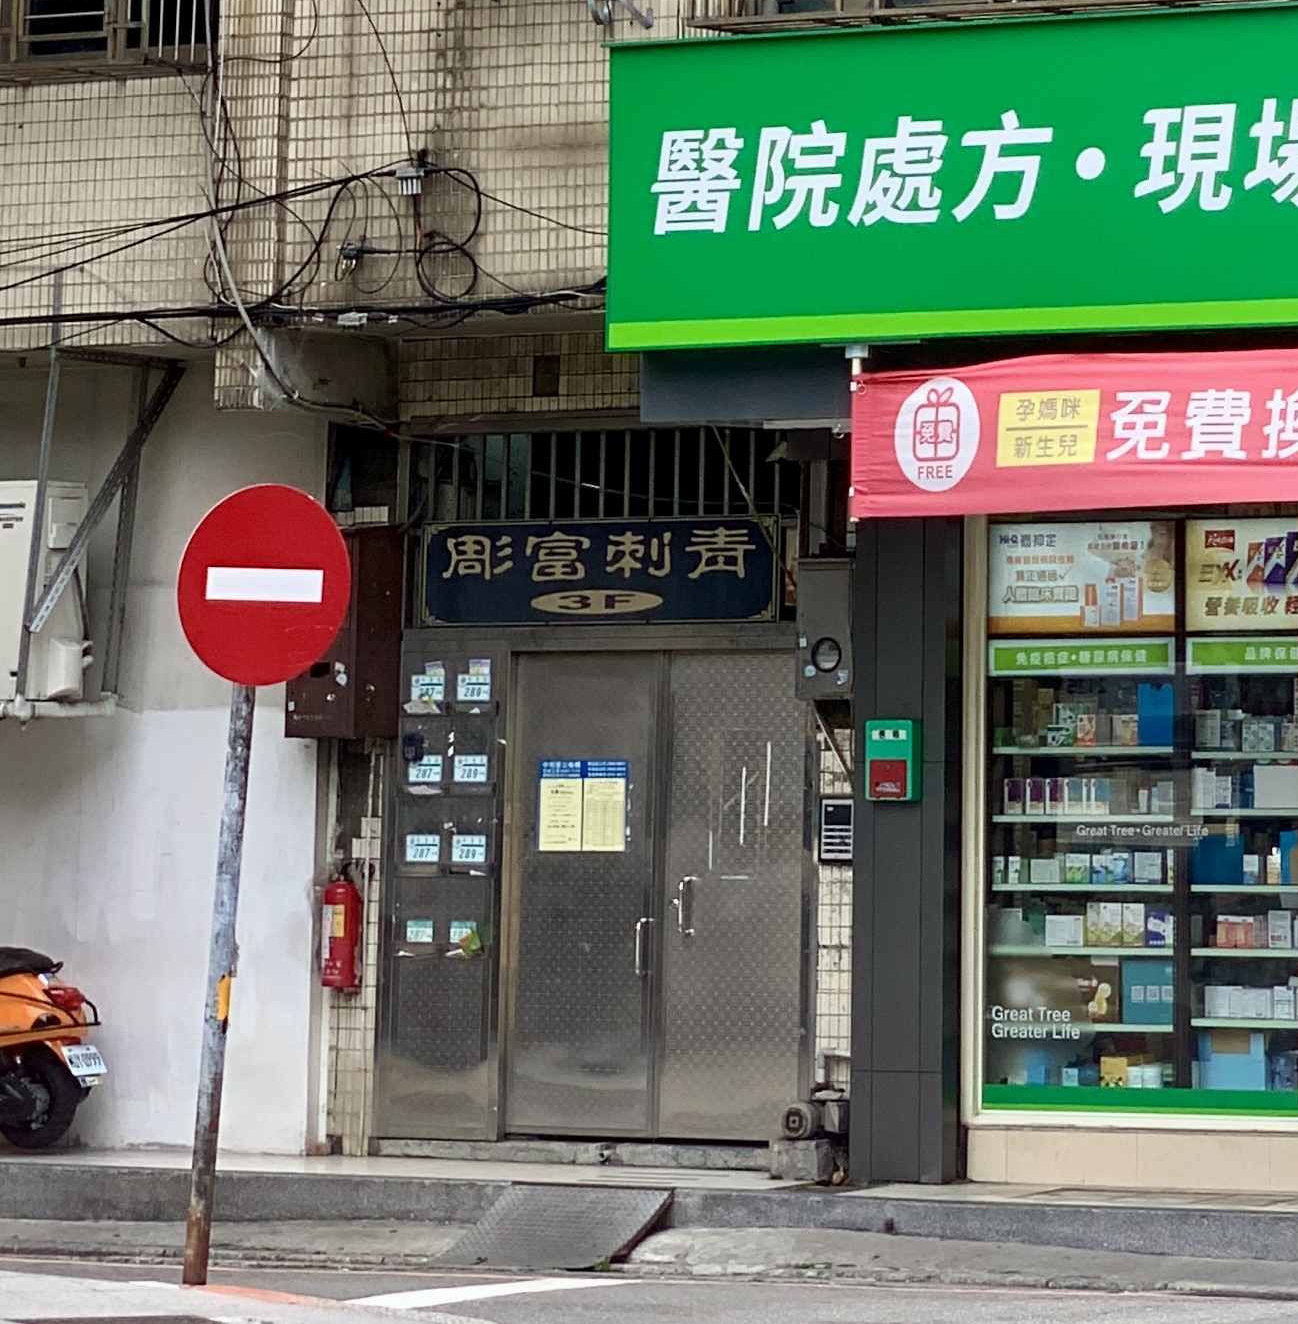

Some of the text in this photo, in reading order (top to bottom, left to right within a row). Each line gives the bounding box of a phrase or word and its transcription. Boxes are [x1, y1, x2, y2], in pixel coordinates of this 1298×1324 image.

[1015, 396, 1081, 422] 孕媽咪
[1012, 434, 1078, 459] 新生兒
[917, 464, 953, 480] FREE
[558, 594, 637, 610] 3F
[1076, 825, 1209, 837] Great Tree Greater Life
[991, 1005, 1071, 1021] Great Tree
[991, 1022, 1081, 1039] Greater Life
